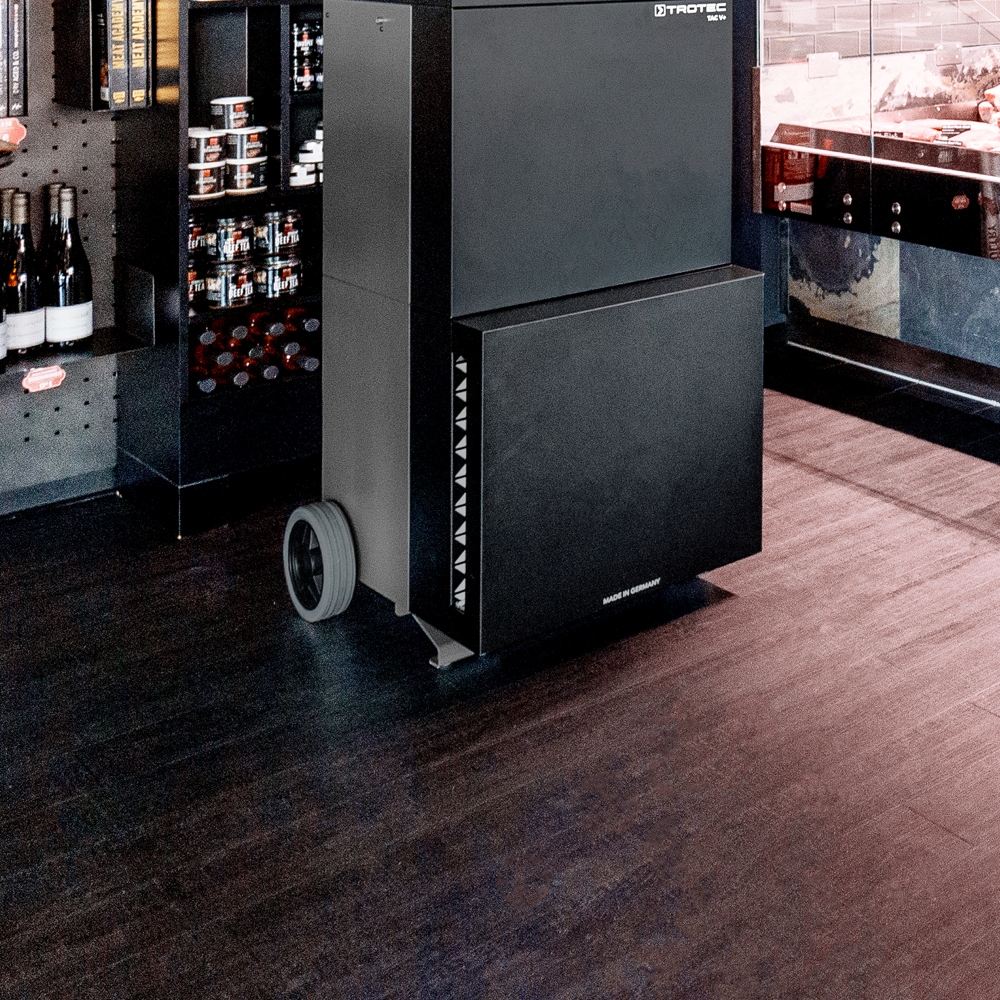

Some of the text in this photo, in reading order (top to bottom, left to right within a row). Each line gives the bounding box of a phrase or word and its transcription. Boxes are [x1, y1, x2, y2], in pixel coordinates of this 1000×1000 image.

[666, 2, 727, 15] TROTEC
[112, 43, 125, 70] MEAT
[131, 42, 145, 68] MEAT
[603, 577, 661, 605] MADE IN GERMANY
